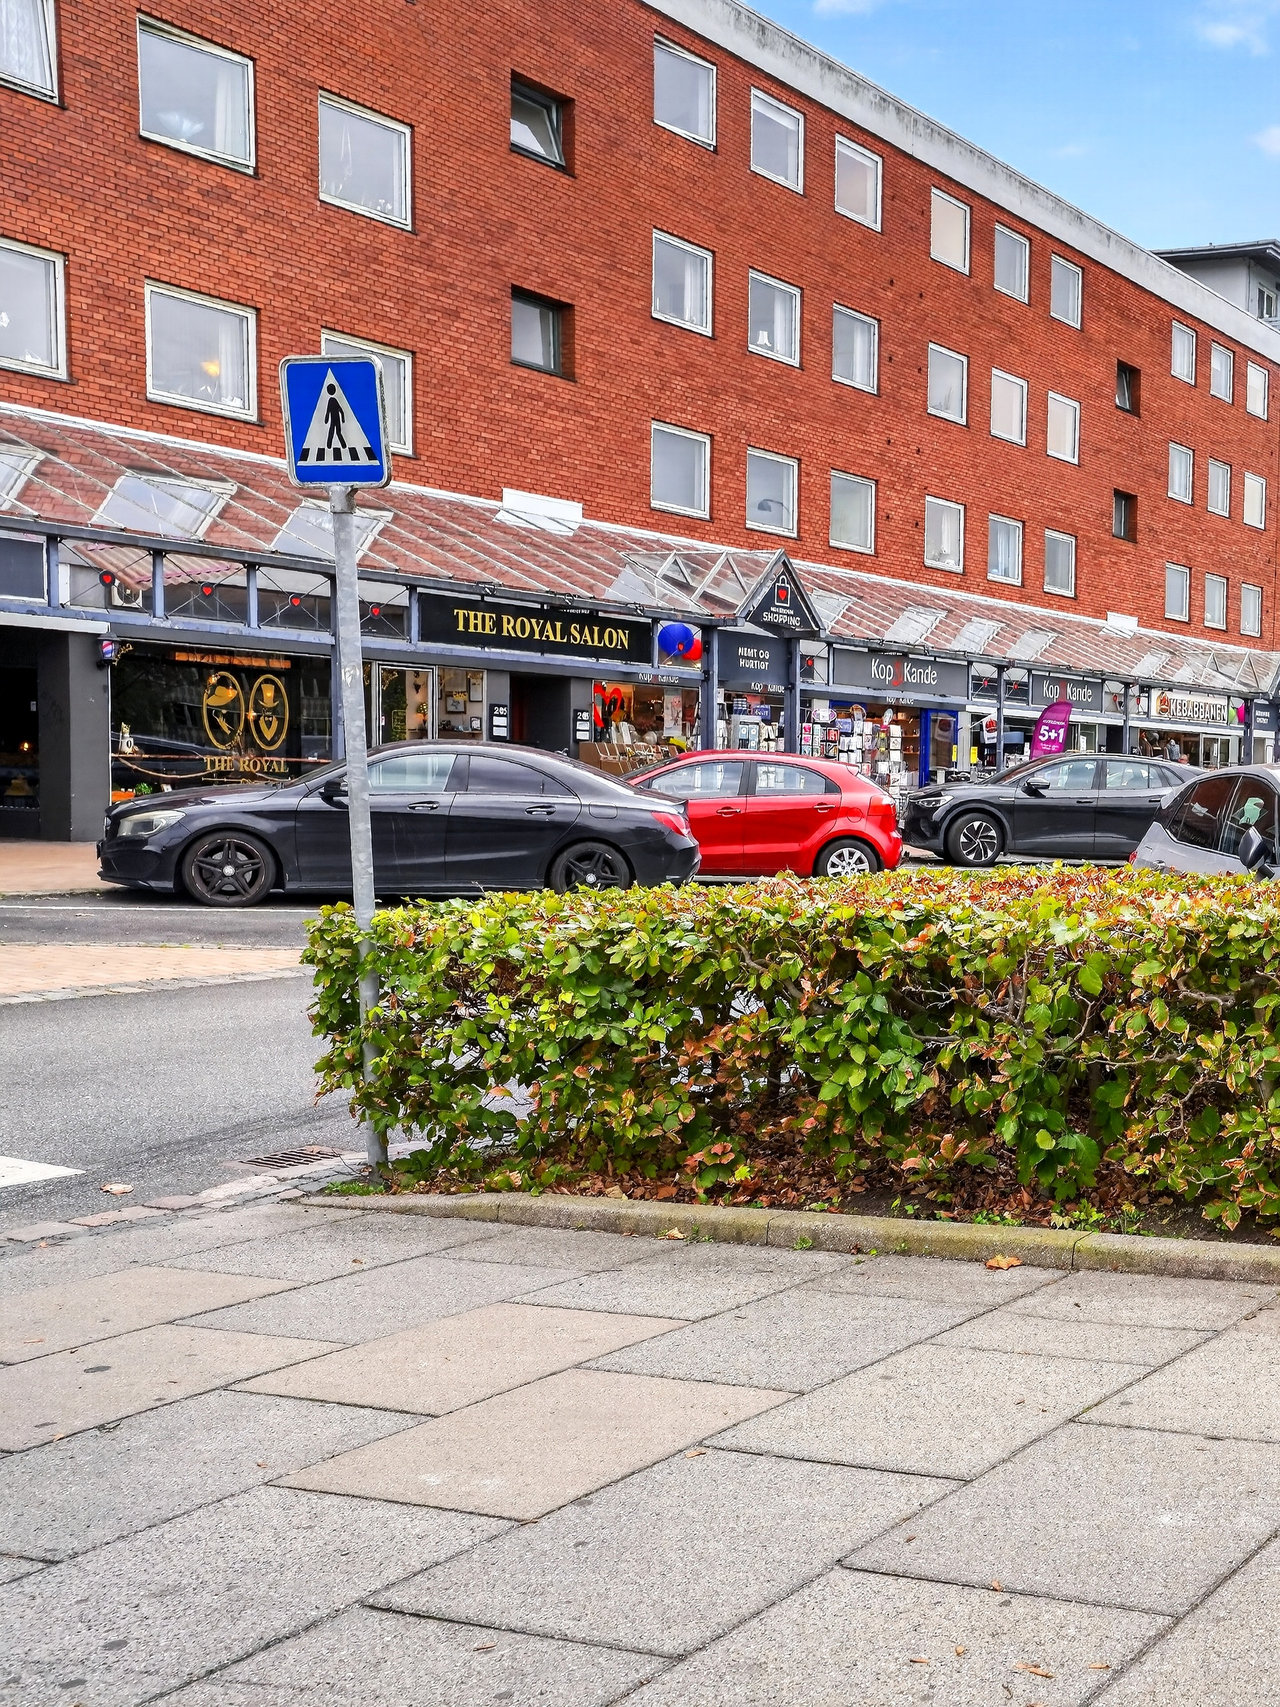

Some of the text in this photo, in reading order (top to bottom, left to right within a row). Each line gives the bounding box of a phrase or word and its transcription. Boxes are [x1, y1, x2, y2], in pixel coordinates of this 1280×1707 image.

[763, 611, 801, 626] SHOPPING
[454, 609, 630, 650] THE ROYAL SALON
[871, 658, 937, 685] Kop Kande
[1043, 680, 1092, 702] Kop Kande
[1038, 725, 1065, 743] 5+1
[203, 755, 290, 773] THE ROYAL
